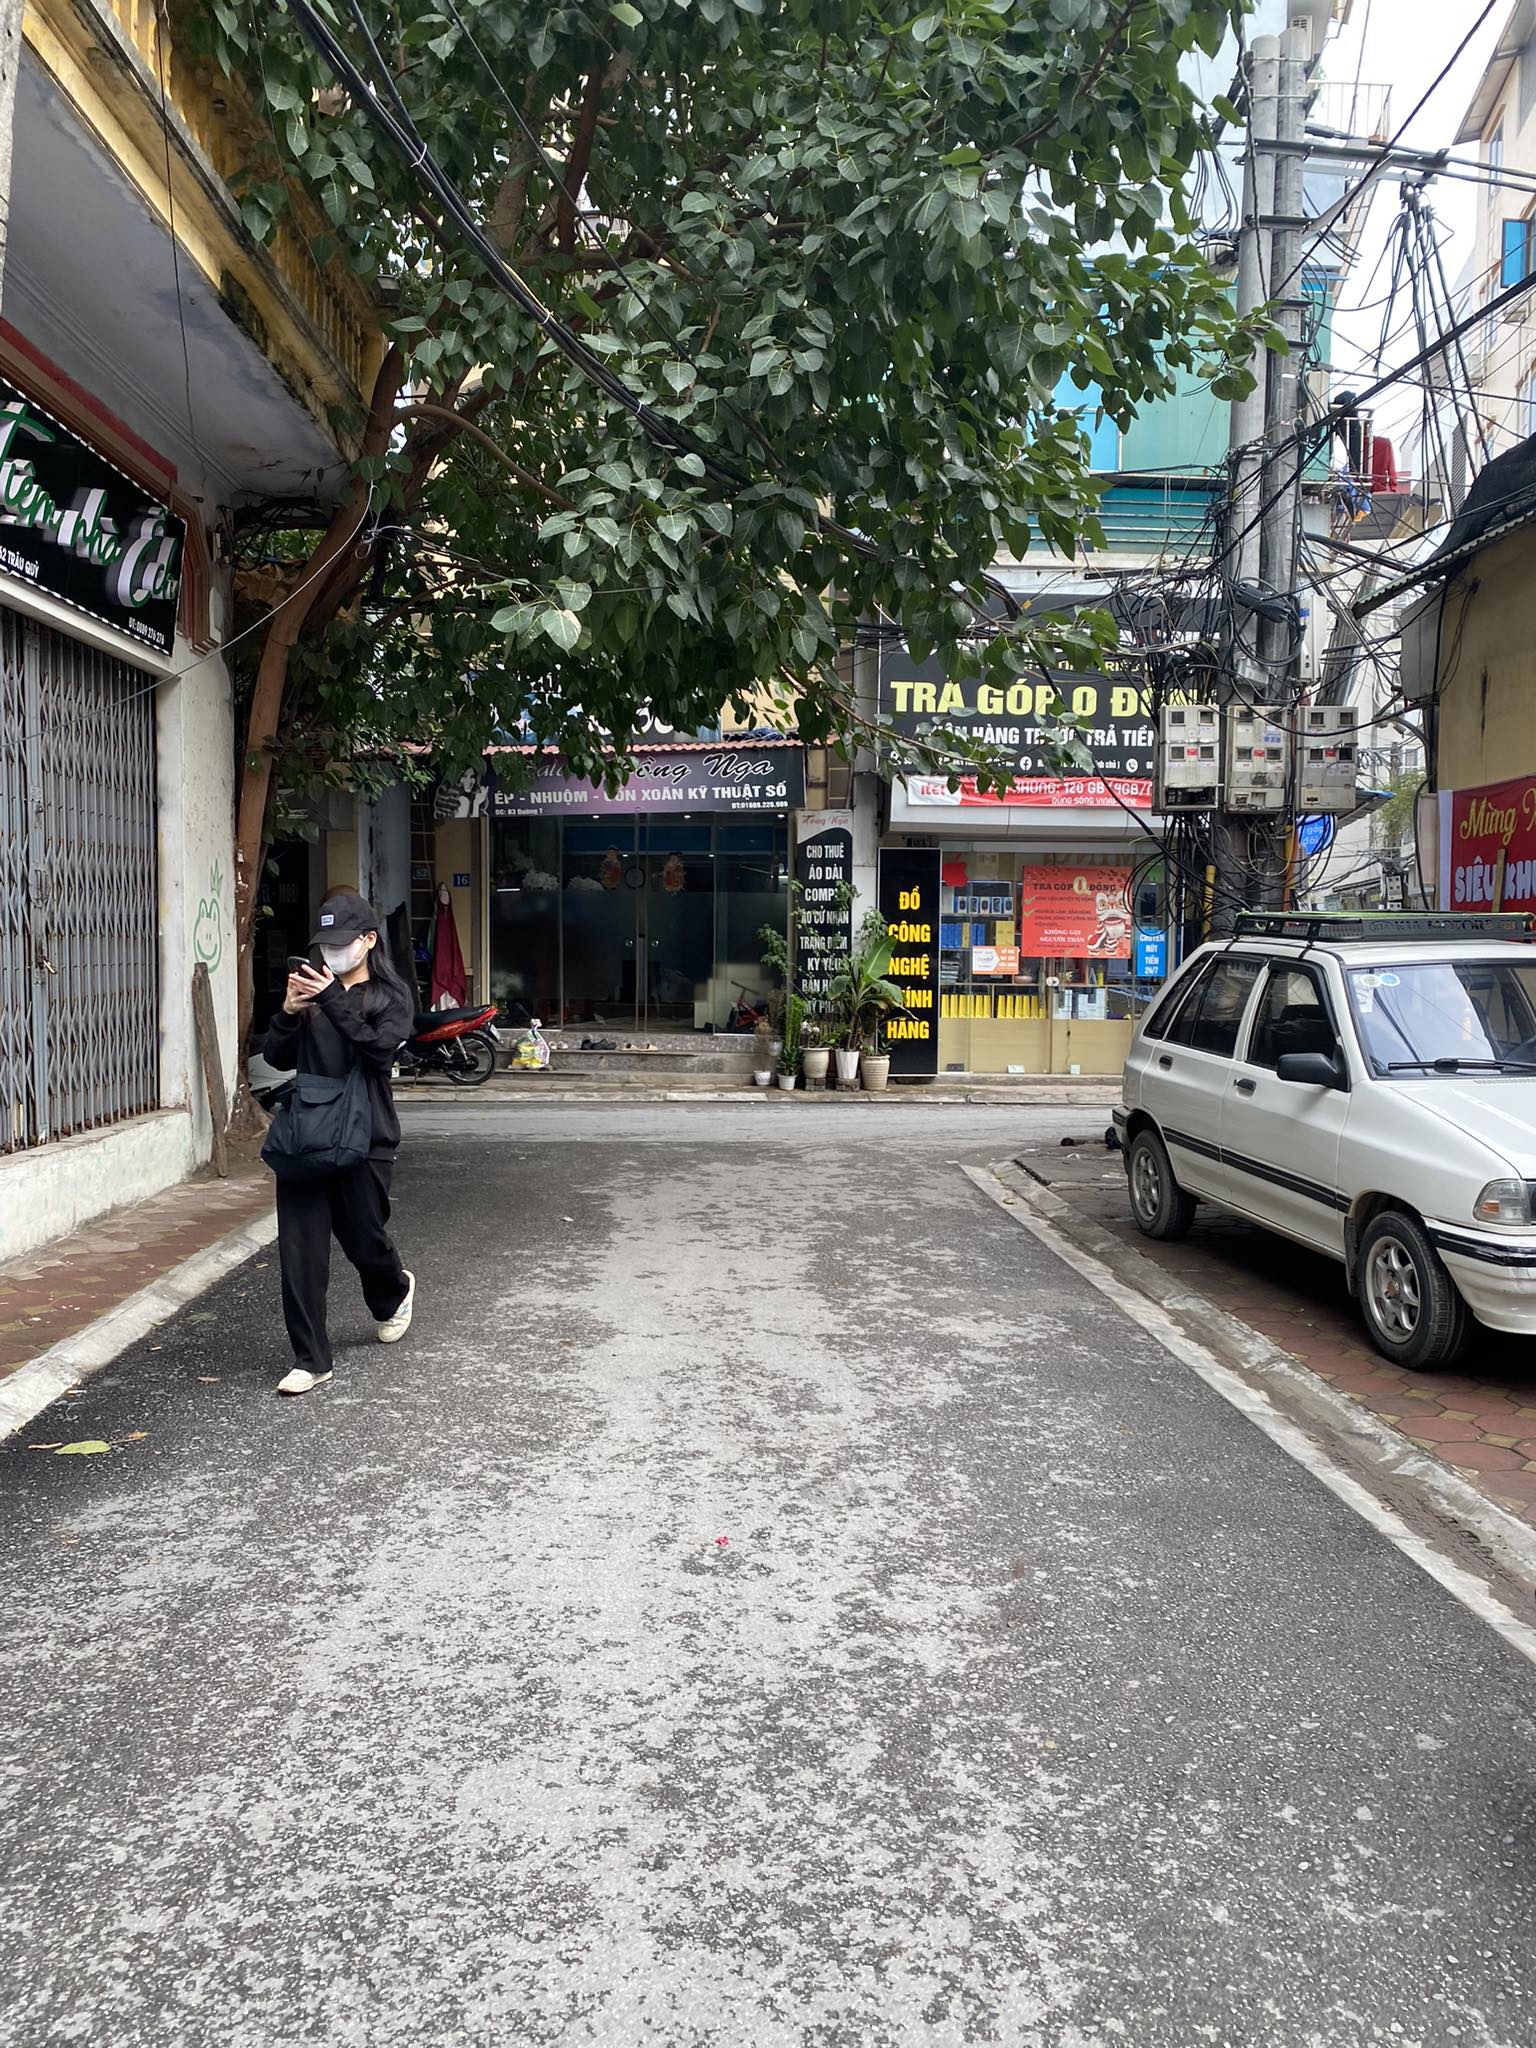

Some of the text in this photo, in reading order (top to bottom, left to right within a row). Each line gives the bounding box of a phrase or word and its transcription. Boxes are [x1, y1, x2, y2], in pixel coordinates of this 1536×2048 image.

[8, 550, 25, 571] TRÂU
[977, 678, 1062, 716] GÓP
[1085, 724, 1118, 747] TRẢ
[702, 752, 775, 784] Nga
[530, 789, 588, 806] NHUỘM
[641, 786, 684, 801] XOĂN
[688, 784, 707, 800] KỸ
[712, 783, 762, 801] THUẬT
[765, 780, 787, 797] SỐ
[1064, 781, 1084, 794] 120
[1087, 781, 1105, 794] GB
[1460, 797, 1518, 846] Mừng
[806, 842, 845, 859] CHO THUÊ
[456, 875, 467, 886] 16
[808, 863, 843, 880] ÁO DÀI
[1455, 855, 1498, 903] SIÊU
[898, 885, 921, 910] ĐỒ
[888, 920, 931, 943] CÔNG
[888, 953, 930, 980] NGHỆ
[887, 1016, 930, 1040] HÃNG
